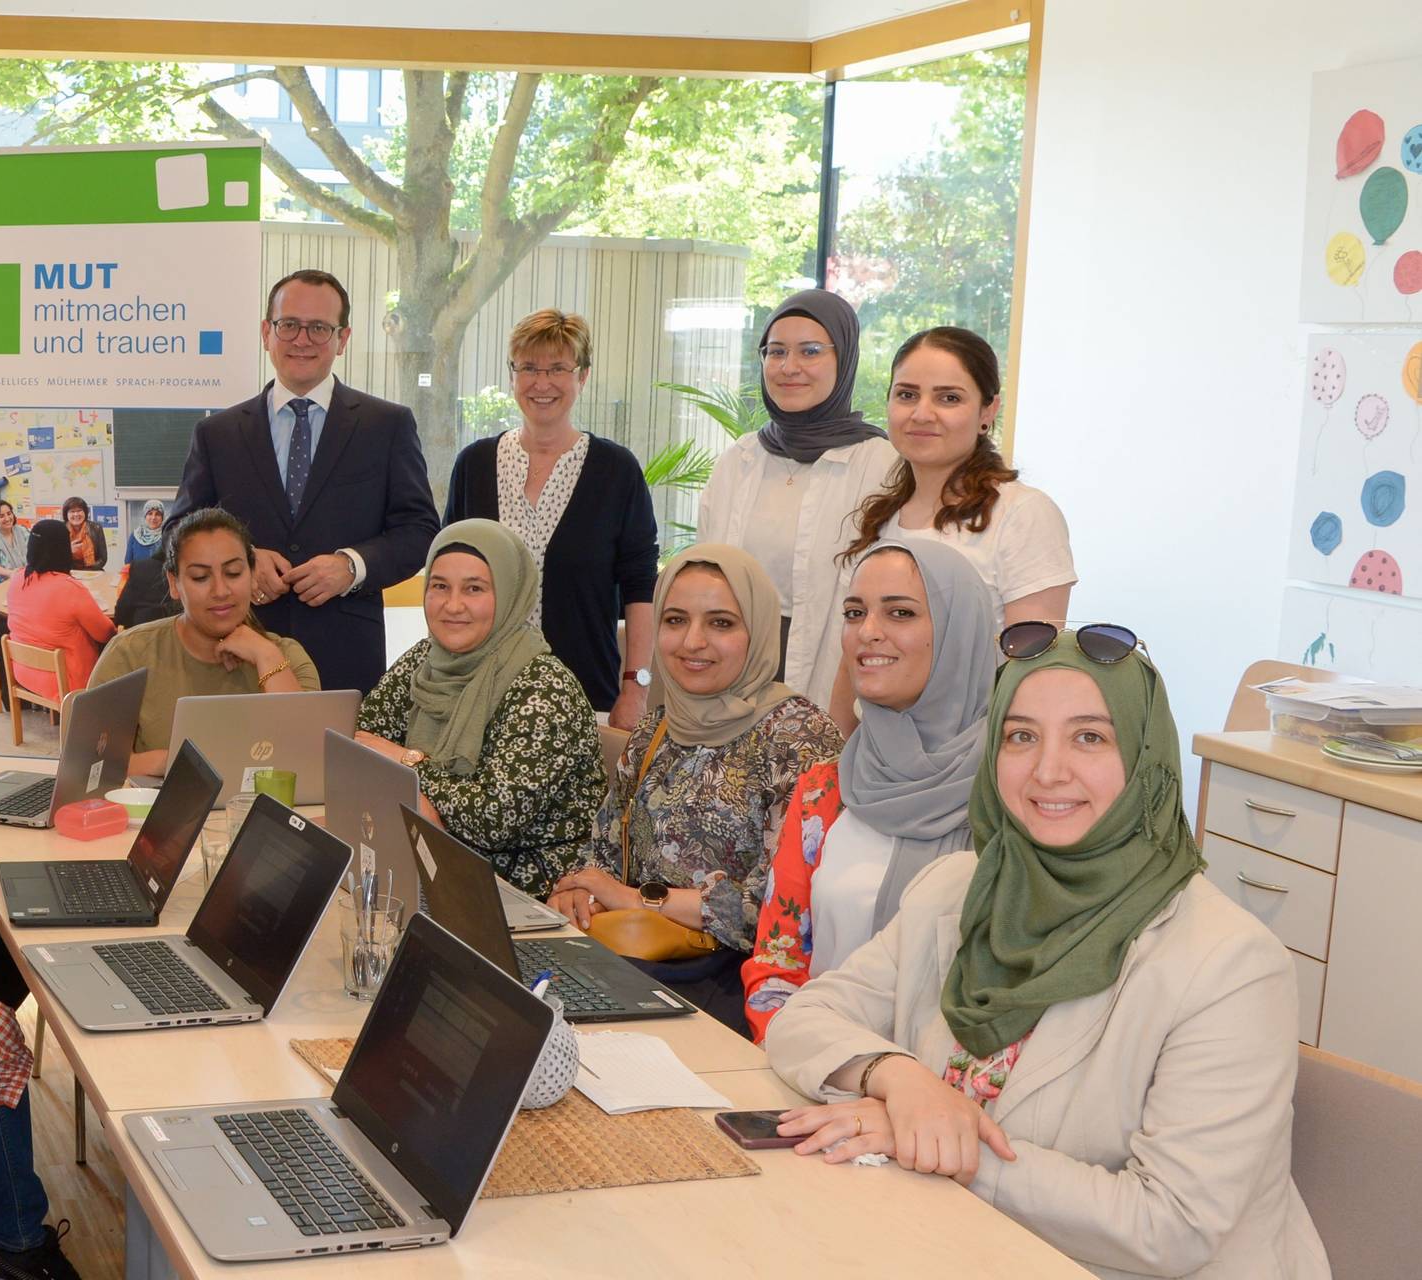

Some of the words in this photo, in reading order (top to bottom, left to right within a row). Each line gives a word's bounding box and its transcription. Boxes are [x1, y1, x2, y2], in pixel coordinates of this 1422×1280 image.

[34, 263, 118, 289] MUT
[34, 295, 186, 321] mitmachen
[33, 328, 83, 354] und
[96, 331, 186, 354] trauen
[47, 375, 108, 386] MÜLHEIMER
[116, 377, 221, 387] SPRACH-PROGRAMM
